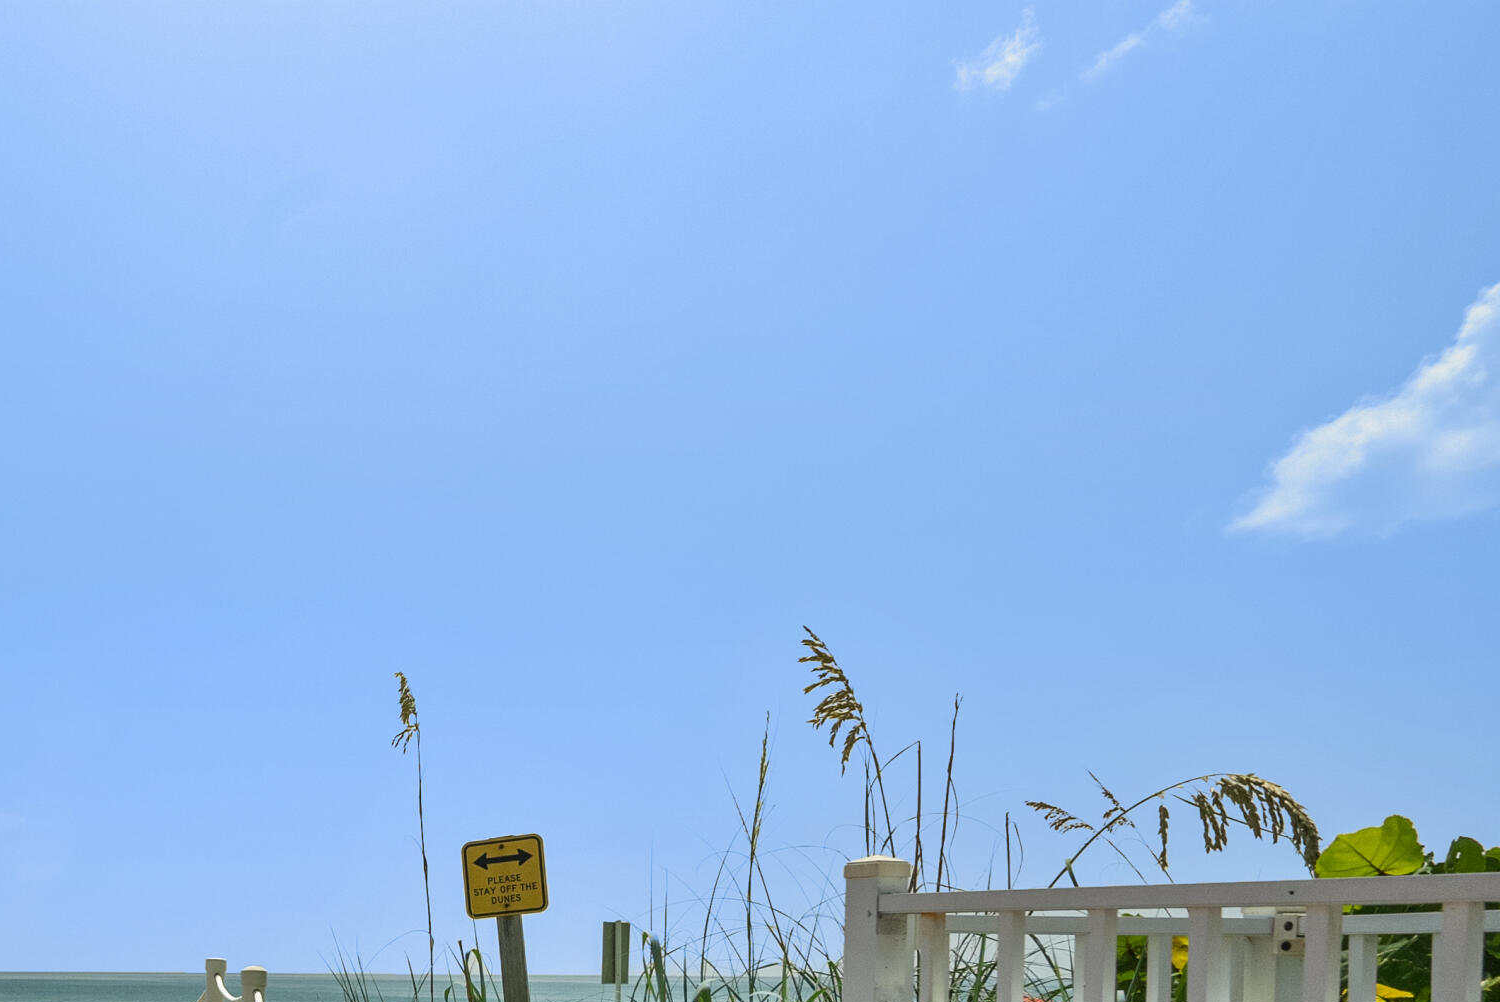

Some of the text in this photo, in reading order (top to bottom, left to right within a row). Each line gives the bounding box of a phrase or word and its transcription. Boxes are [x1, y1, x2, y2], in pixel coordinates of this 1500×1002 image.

[487, 874, 522, 885] PLEASE
[473, 882, 538, 896] STAY OFF THE
[491, 894, 522, 905] DUNES
